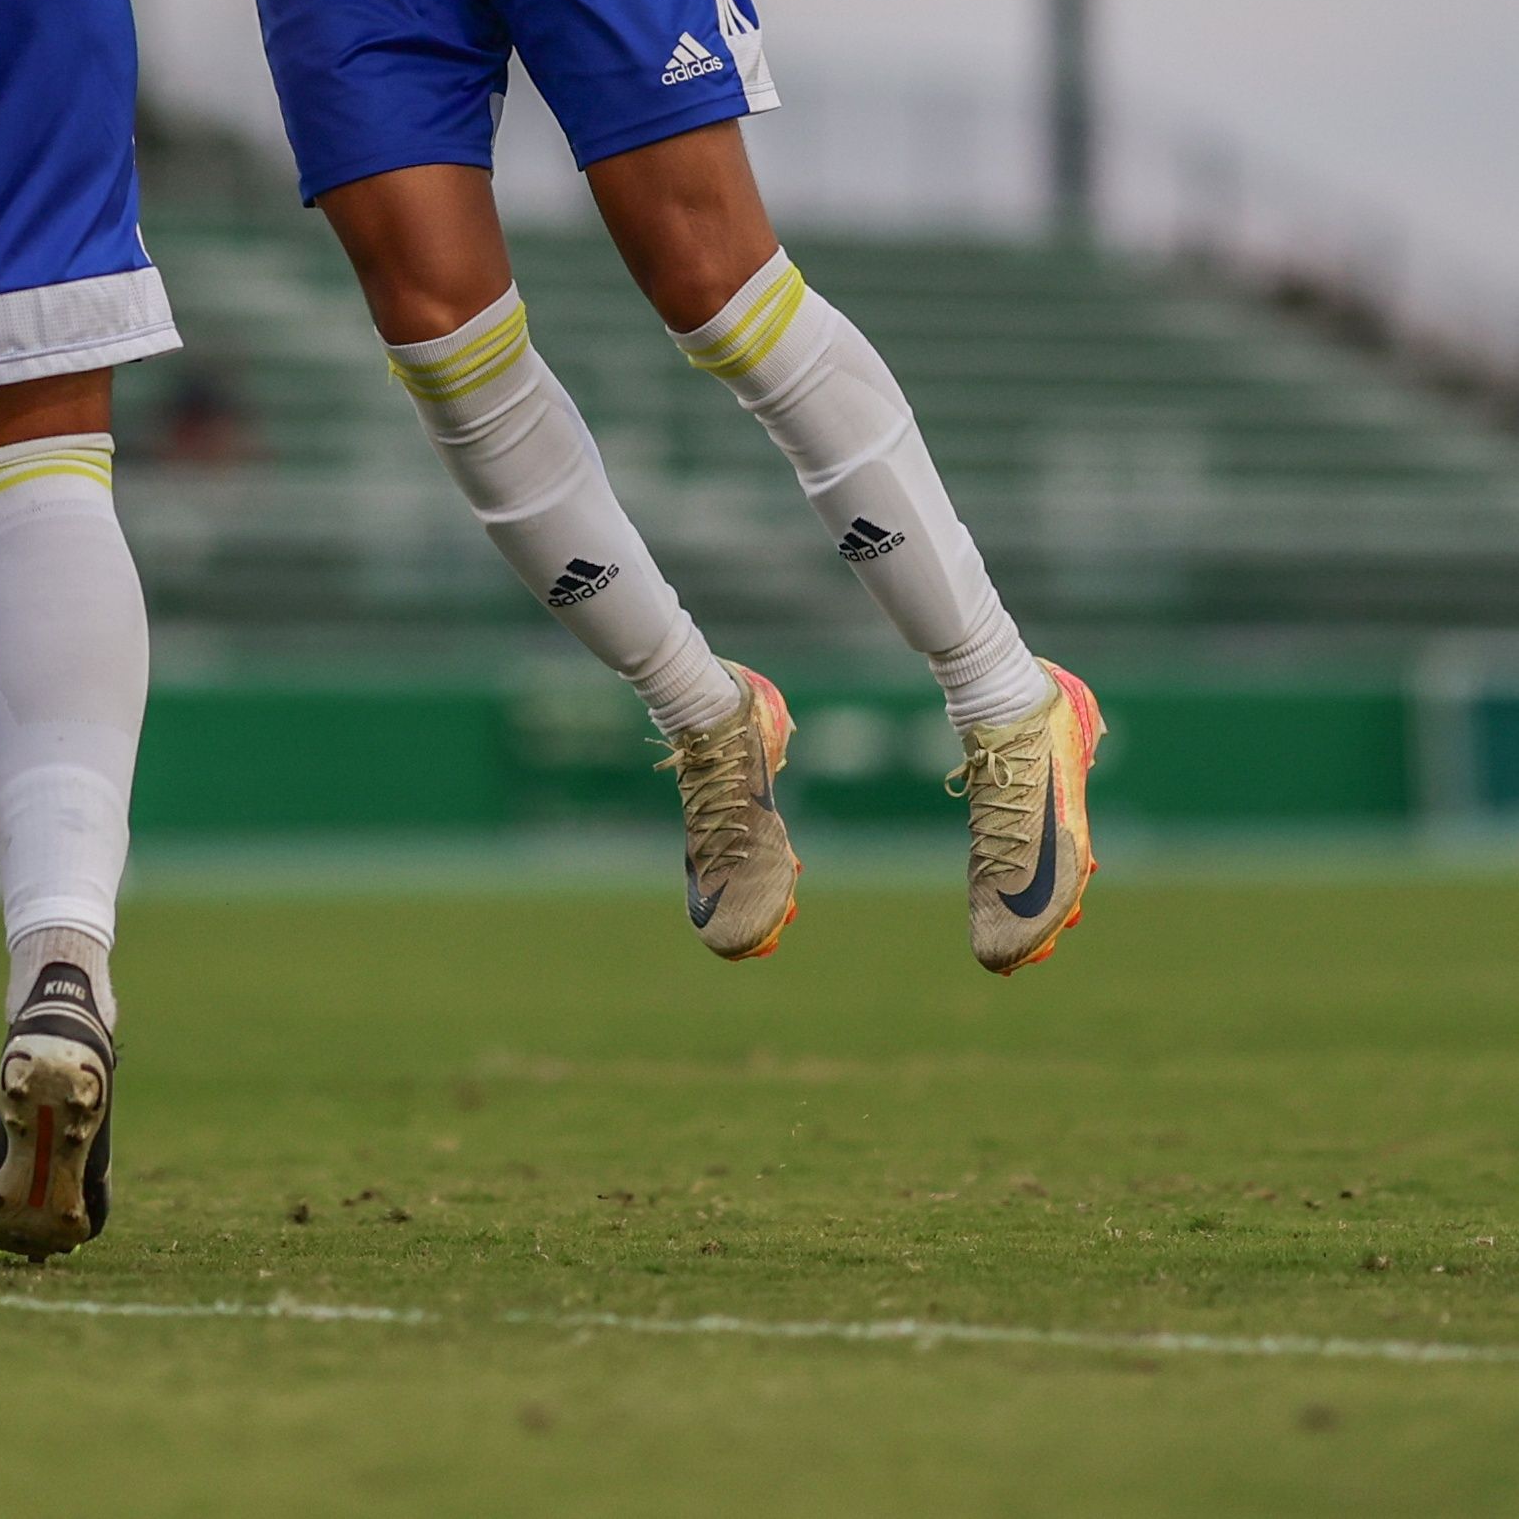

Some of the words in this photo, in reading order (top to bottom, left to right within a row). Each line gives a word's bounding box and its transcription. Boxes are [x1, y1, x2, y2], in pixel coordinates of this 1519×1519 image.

[661, 55, 724, 85] adidas
[548, 563, 620, 607] adidas
[43, 980, 86, 1001] KING
